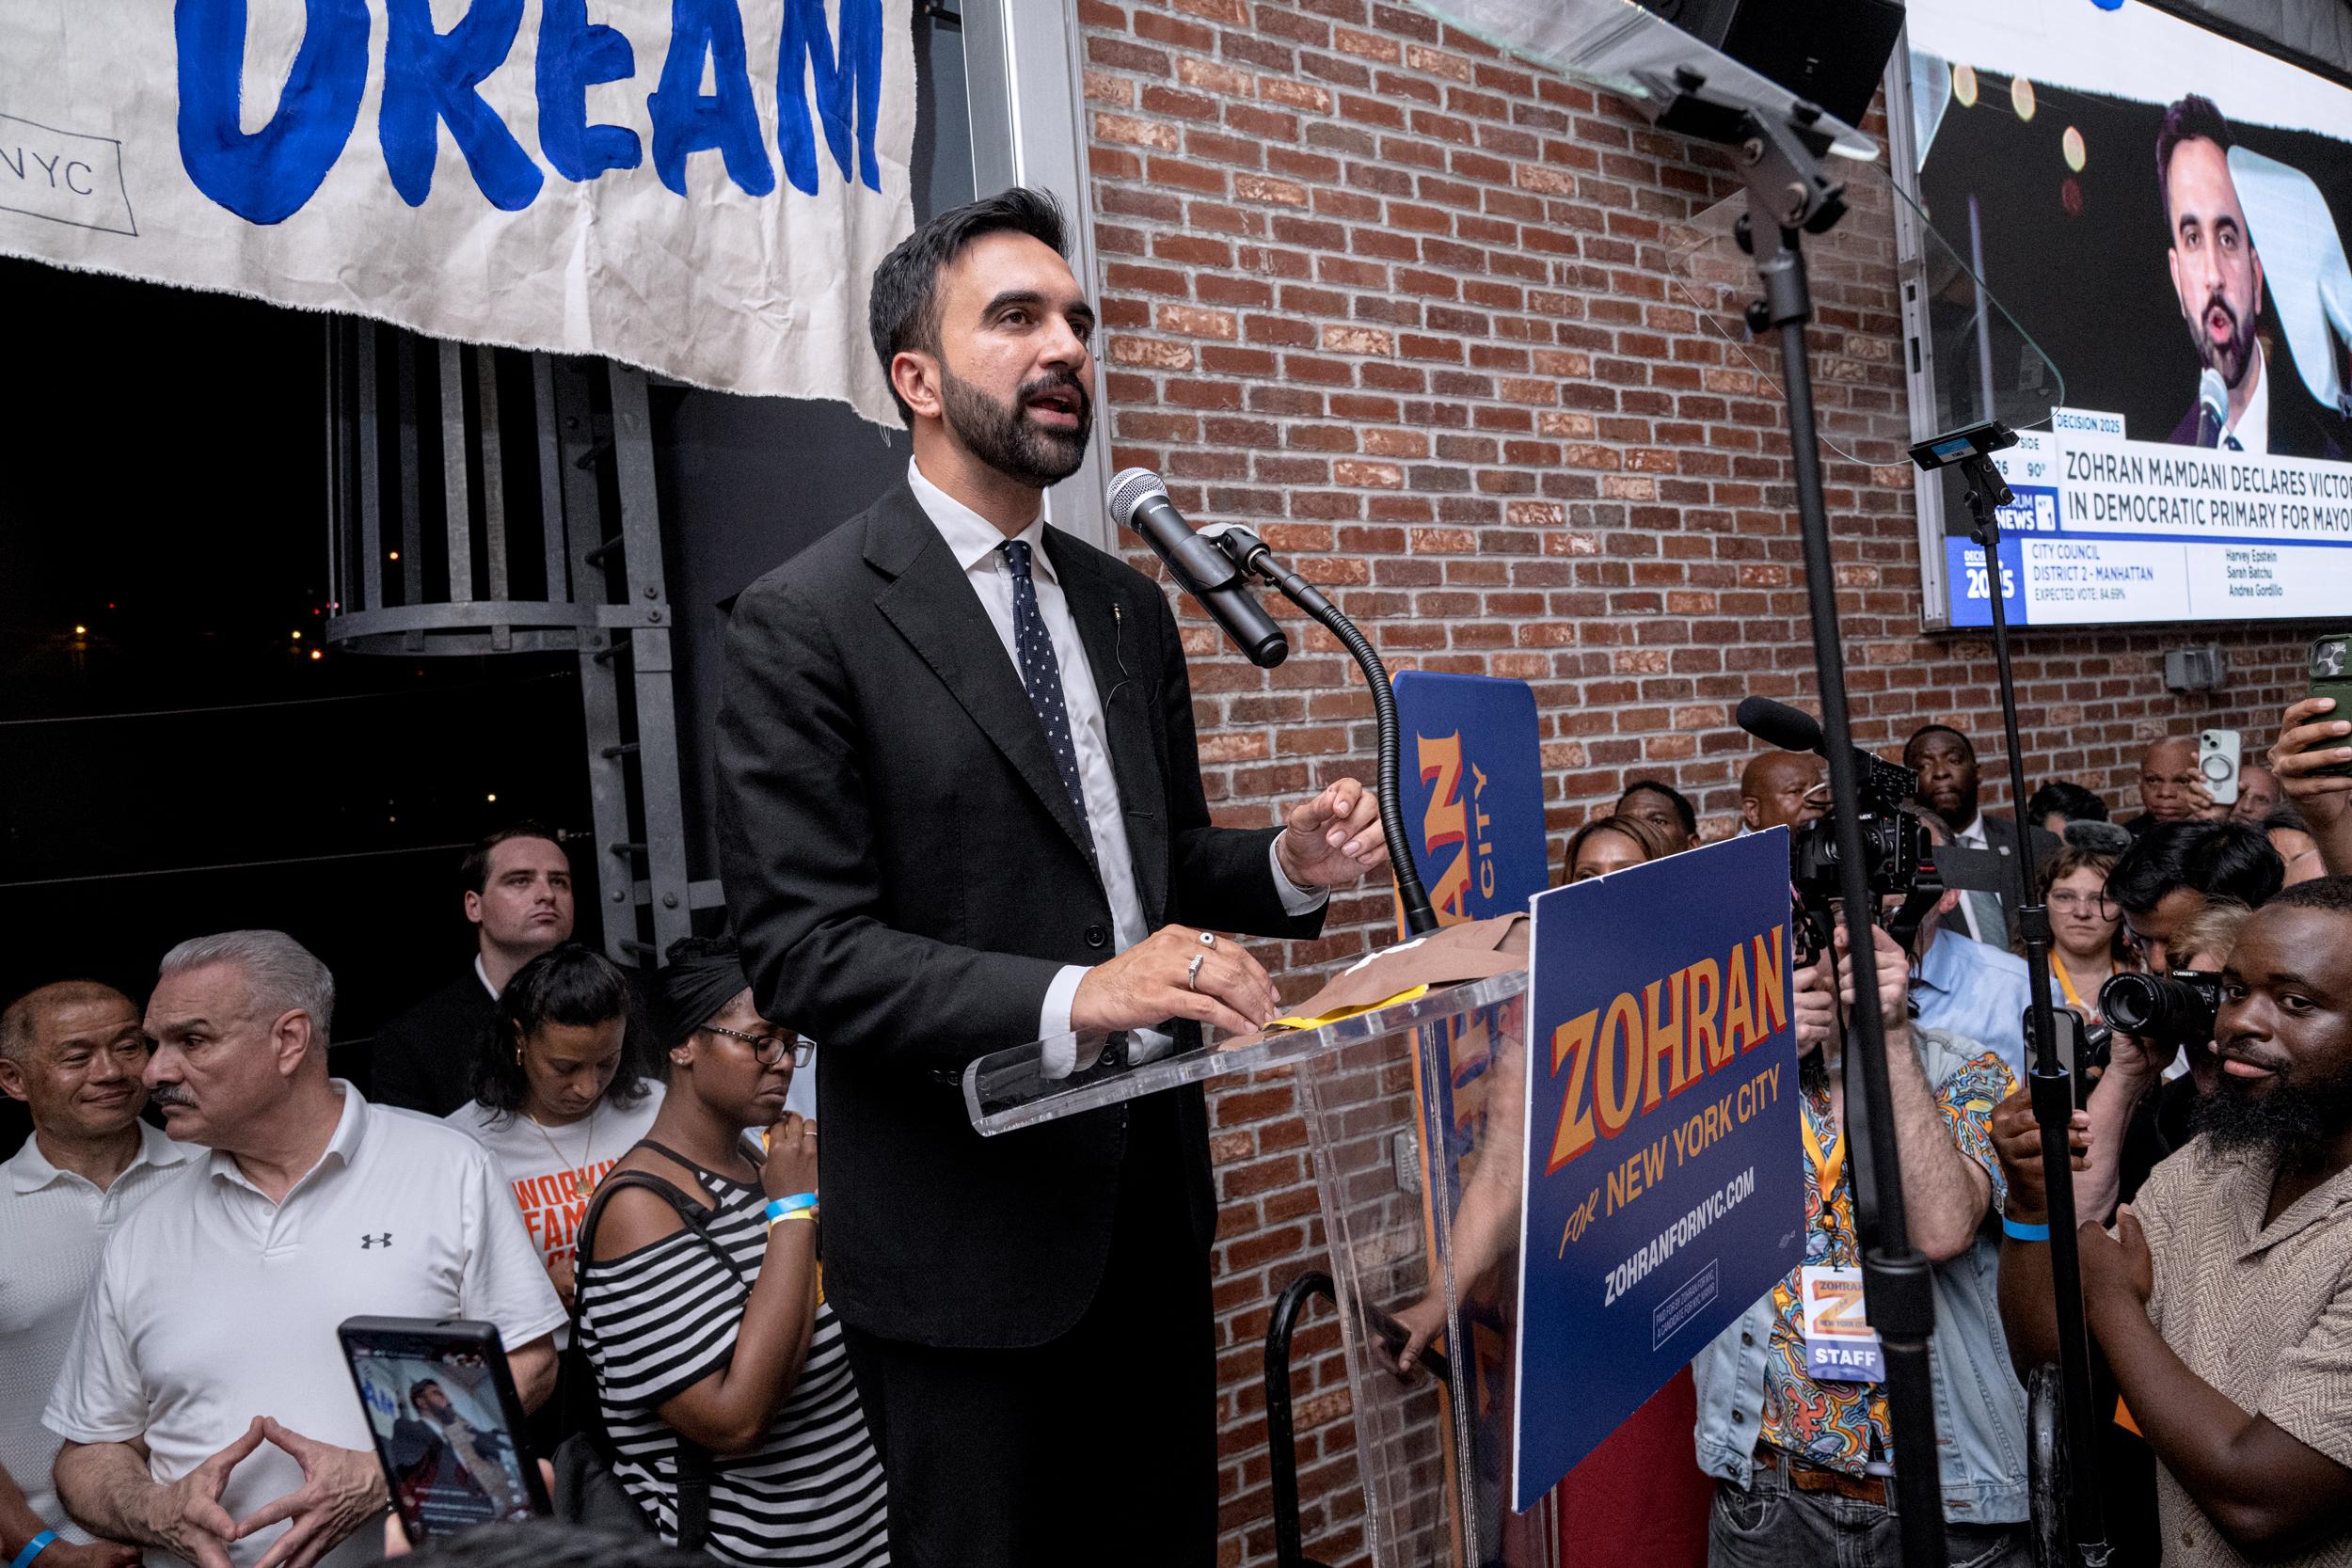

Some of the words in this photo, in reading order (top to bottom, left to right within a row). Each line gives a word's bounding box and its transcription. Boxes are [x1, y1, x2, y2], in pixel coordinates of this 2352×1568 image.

[2057, 414, 2098, 431] DECISION
[2100, 419, 2121, 433] 2025
[2066, 451, 2144, 484] ZOHRAN
[2149, 456, 2227, 490] MAMDANI
[2231, 465, 2307, 497] DECLARES
[2310, 472, 2352, 499] VICTO
[1995, 509, 2035, 531] NEWS
[2068, 490, 2088, 520] IN
[2093, 492, 2206, 525] DEMOCRATIC
[2210, 499, 2277, 530] PRIMARY
[2281, 504, 2310, 531] FOR
[2313, 506, 2352, 531] MAYO
[2032, 544, 2054, 559] CITY
[2057, 544, 2100, 560] COUNCIL
[2226, 549, 2250, 564] Harvey
[2251, 549, 2278, 562] Epstein
[2034, 565, 2078, 581] DISTRICT
[2081, 566, 2087, 581] 2
[2095, 566, 2153, 581] MANHATTAN
[2227, 565, 2247, 578] Sarah
[1965, 568, 2015, 599] 205
[2035, 587, 2074, 601] EXPECTED
[1472, 762, 1494, 899] CITY
[1545, 924, 1788, 1177] ZOHRAN
[1559, 1187, 1599, 1259] FOR
[1607, 1135, 1668, 1217] NEW
[1672, 1093, 1733, 1167] YORK
[1738, 1063, 1780, 1124] CITY
[1605, 1166, 1755, 1307] ZOHRANFORNYC.COM
[1815, 1348, 1877, 1367] STAFF
